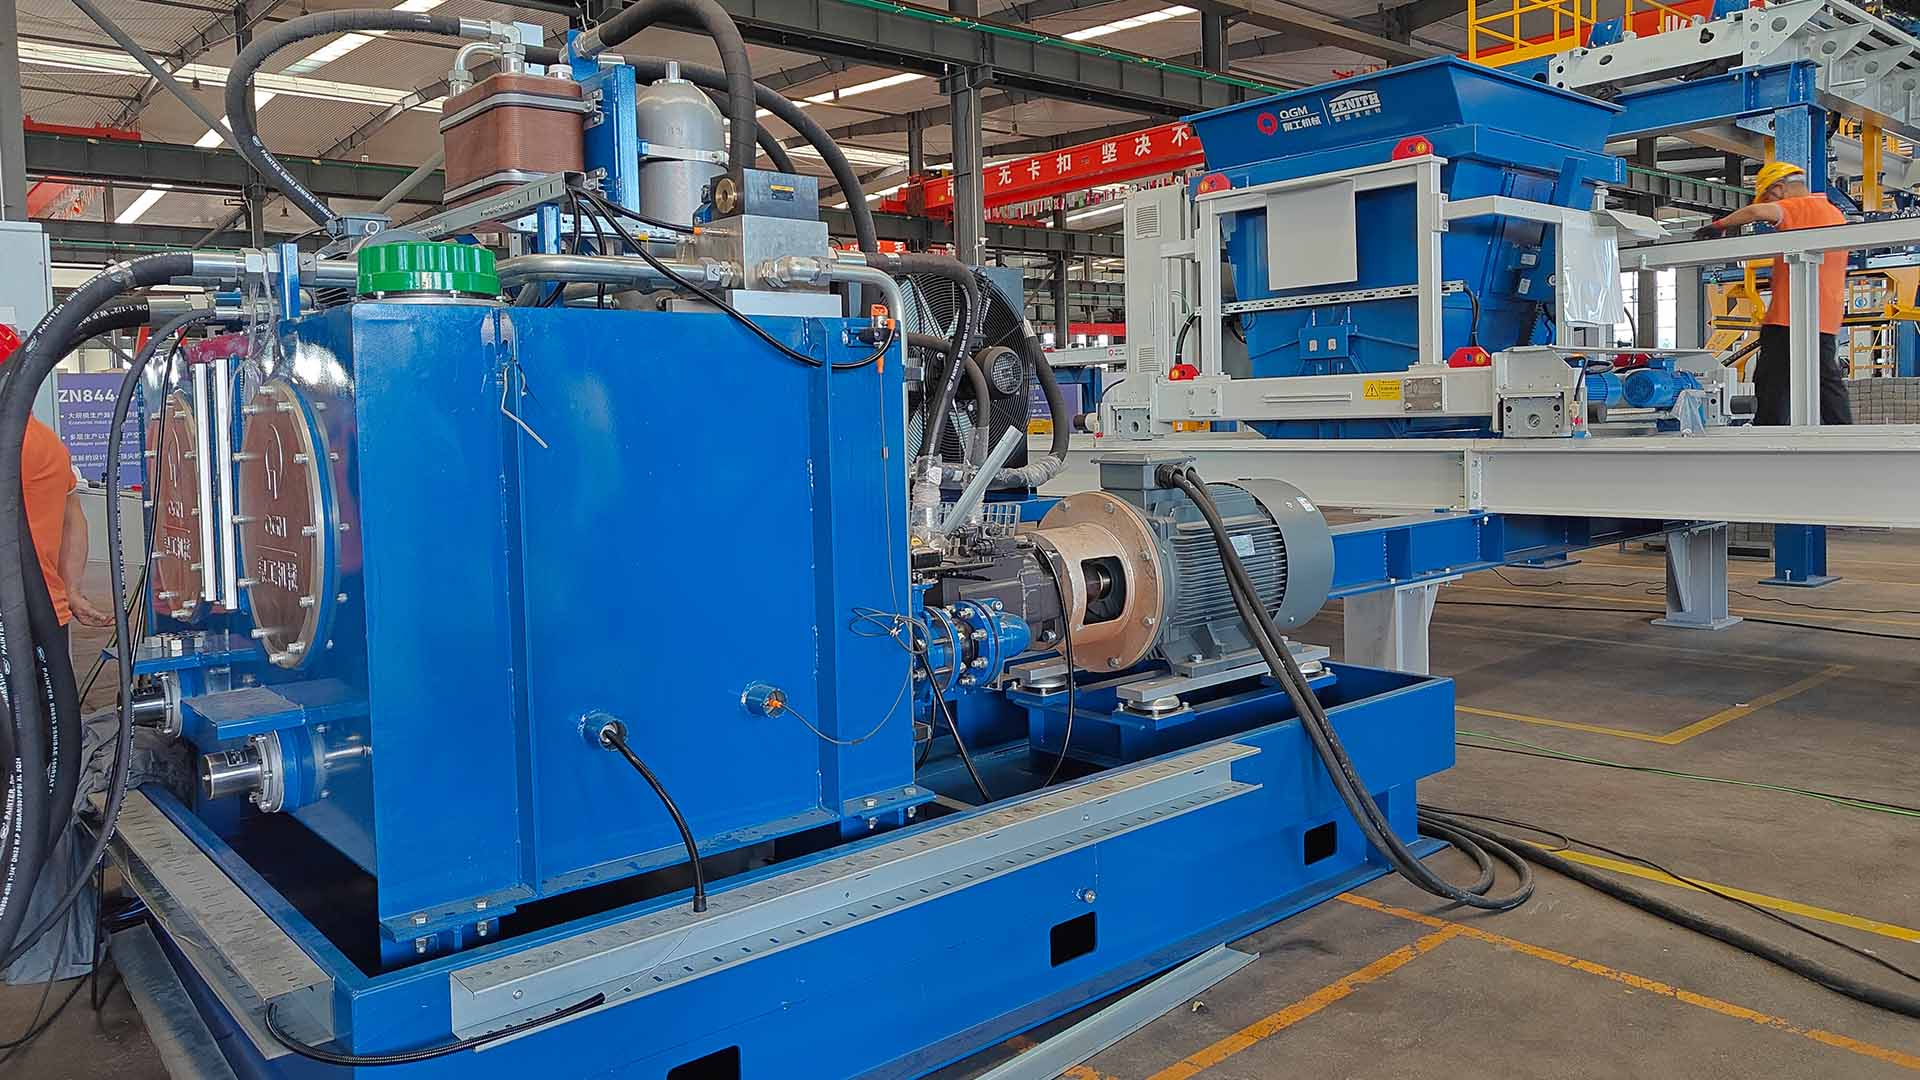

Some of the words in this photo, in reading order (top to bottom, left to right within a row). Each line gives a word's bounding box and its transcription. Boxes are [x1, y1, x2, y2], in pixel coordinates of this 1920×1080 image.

[1280, 105, 1309, 119] QGM
[1329, 92, 1381, 114] ZENITH
[38, 303, 65, 335] PAINTER
[136, 303, 149, 312] DN
[42, 667, 54, 699] PAINTER
[4, 787, 16, 821] PAINTER
